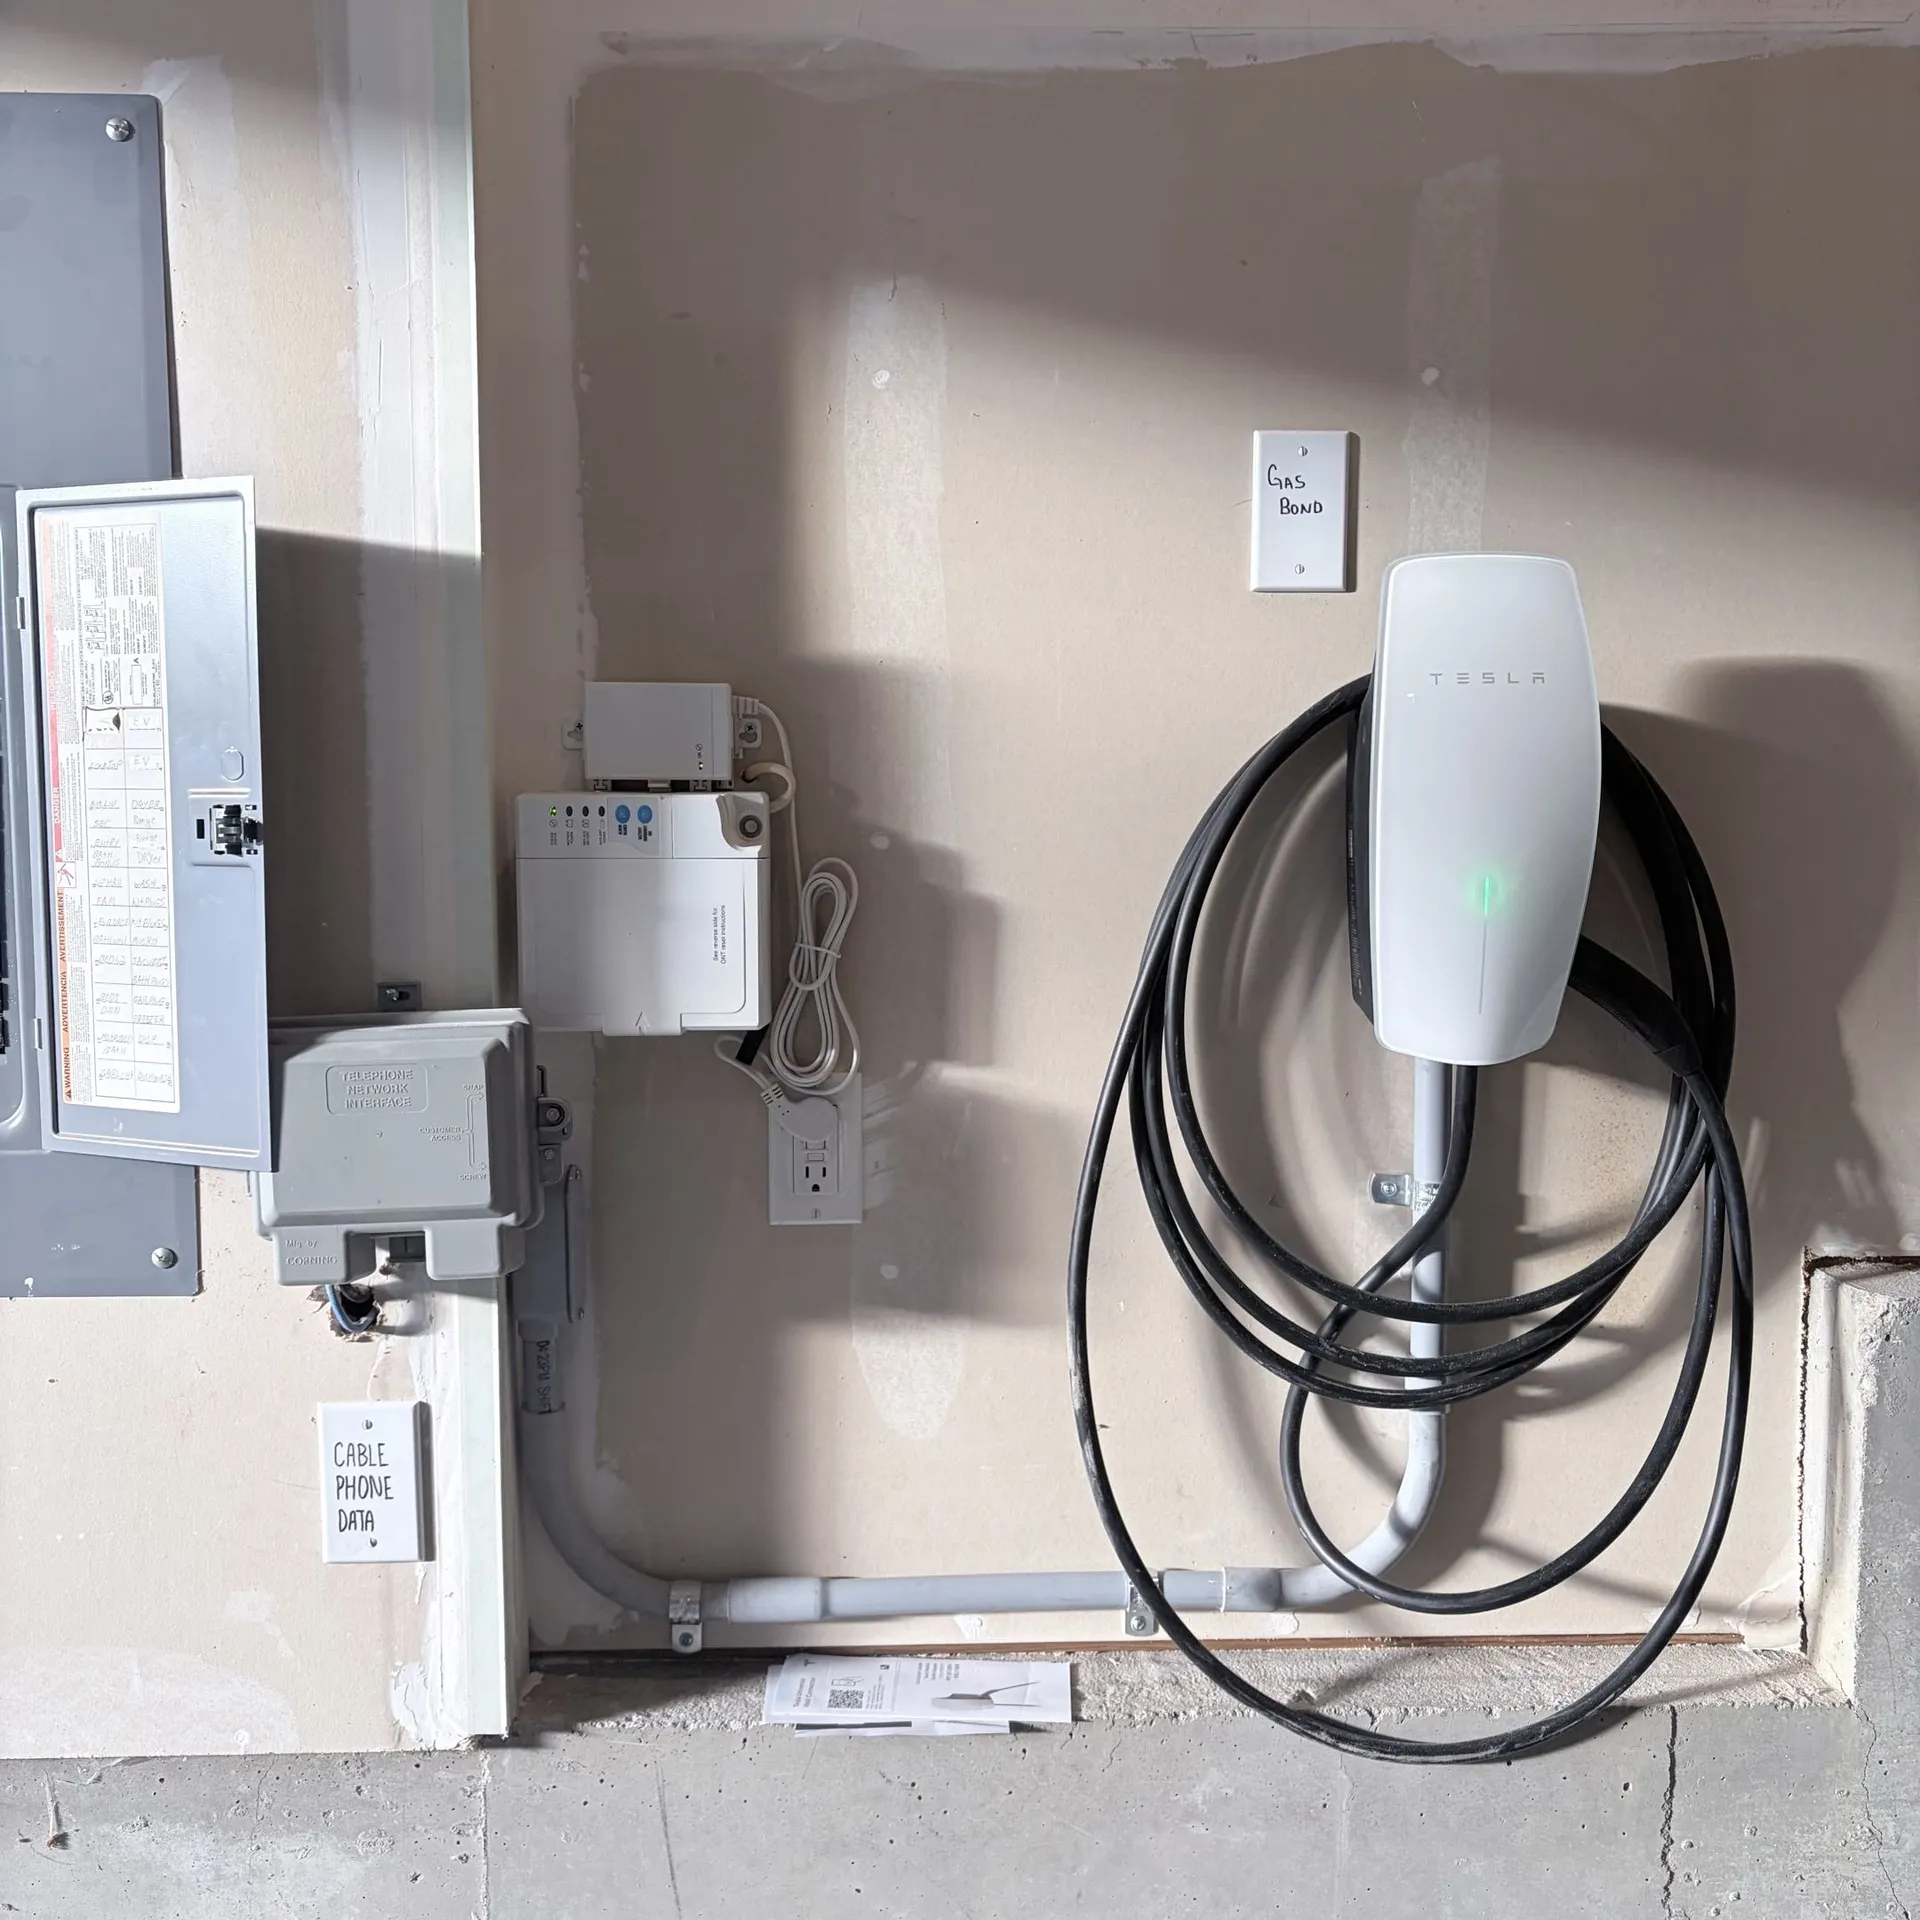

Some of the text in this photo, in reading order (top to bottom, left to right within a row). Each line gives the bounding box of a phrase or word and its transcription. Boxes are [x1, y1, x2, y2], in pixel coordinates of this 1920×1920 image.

[1267, 463, 1306, 490] GAS
[1279, 496, 1323, 515] BOND
[1428, 672, 1545, 686] TESLA
[53, 787, 61, 823] DANGER
[57, 890, 66, 963] AVERTISSEMENT
[61, 971, 69, 1034] ADVERTENCIA
[64, 1047, 72, 1089] WARNING
[339, 1069, 413, 1083] TELEPHONE
[347, 1083, 409, 1096] NETWORK
[463, 1084, 484, 1092] SNAP
[344, 1097, 412, 1110] INTERFACE
[419, 1126, 462, 1135] CUSTOMER
[430, 1135, 462, 1143] ACCESS
[458, 1173, 488, 1182] SCREW
[306, 1238, 318, 1250] by
[285, 1255, 338, 1267] CORNING
[537, 1385, 553, 1415] SHIFT
[334, 1441, 389, 1468] CABLE
[336, 1474, 394, 1501] PHONE
[338, 1508, 375, 1533] DATA
